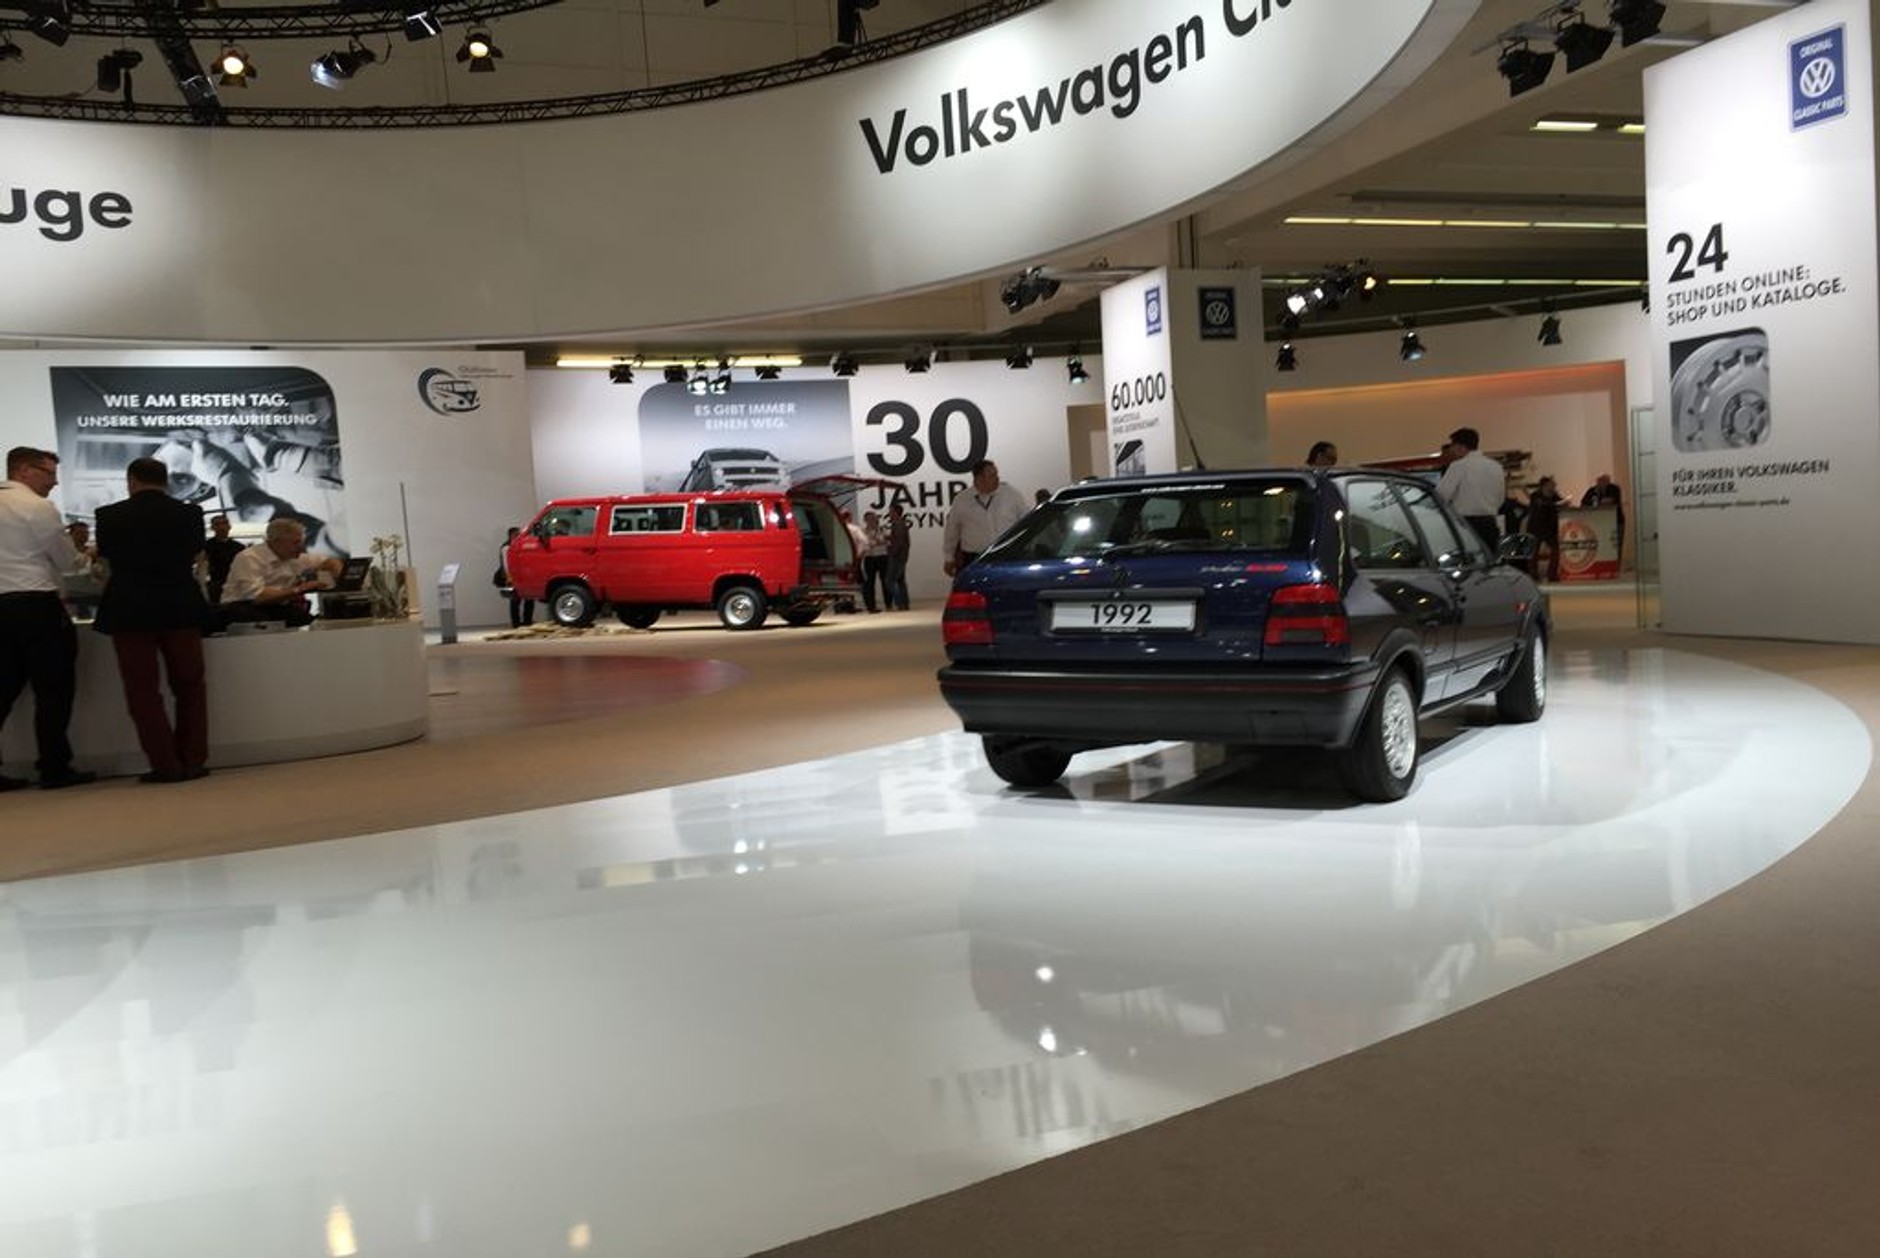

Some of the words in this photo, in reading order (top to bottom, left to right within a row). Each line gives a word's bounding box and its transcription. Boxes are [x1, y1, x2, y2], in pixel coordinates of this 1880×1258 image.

[859, 15, 1205, 174] Volkswagen
[1666, 222, 1729, 283] 24
[1667, 280, 1737, 308] STUNDEN
[1740, 264, 1810, 293] ONLINE:
[1667, 305, 1707, 326] SHOP
[1711, 298, 1748, 317] UND
[1751, 277, 1847, 310] KATALOGE.
[103, 394, 139, 408] WIE
[144, 394, 176, 408] AM
[181, 393, 246, 407] ERSTEN
[249, 392, 289, 407] TAG.
[1111, 371, 1167, 412] 60.000
[77, 414, 138, 427] UNSERE
[141, 413, 317, 427] WERKSRESTAURIERUNG
[694, 404, 711, 417] ES
[713, 403, 746, 416] GIBT
[749, 402, 797, 415] IMMER
[705, 418, 748, 430] EINEN
[866, 398, 989, 477] 30
[1672, 468, 1695, 482] FÜR
[1736, 459, 1829, 478] VOLKSWAGEN
[870, 481, 968, 509] JAHR
[1672, 481, 1738, 497] KLASSIKER.
[1090, 604, 1152, 625] 1992
